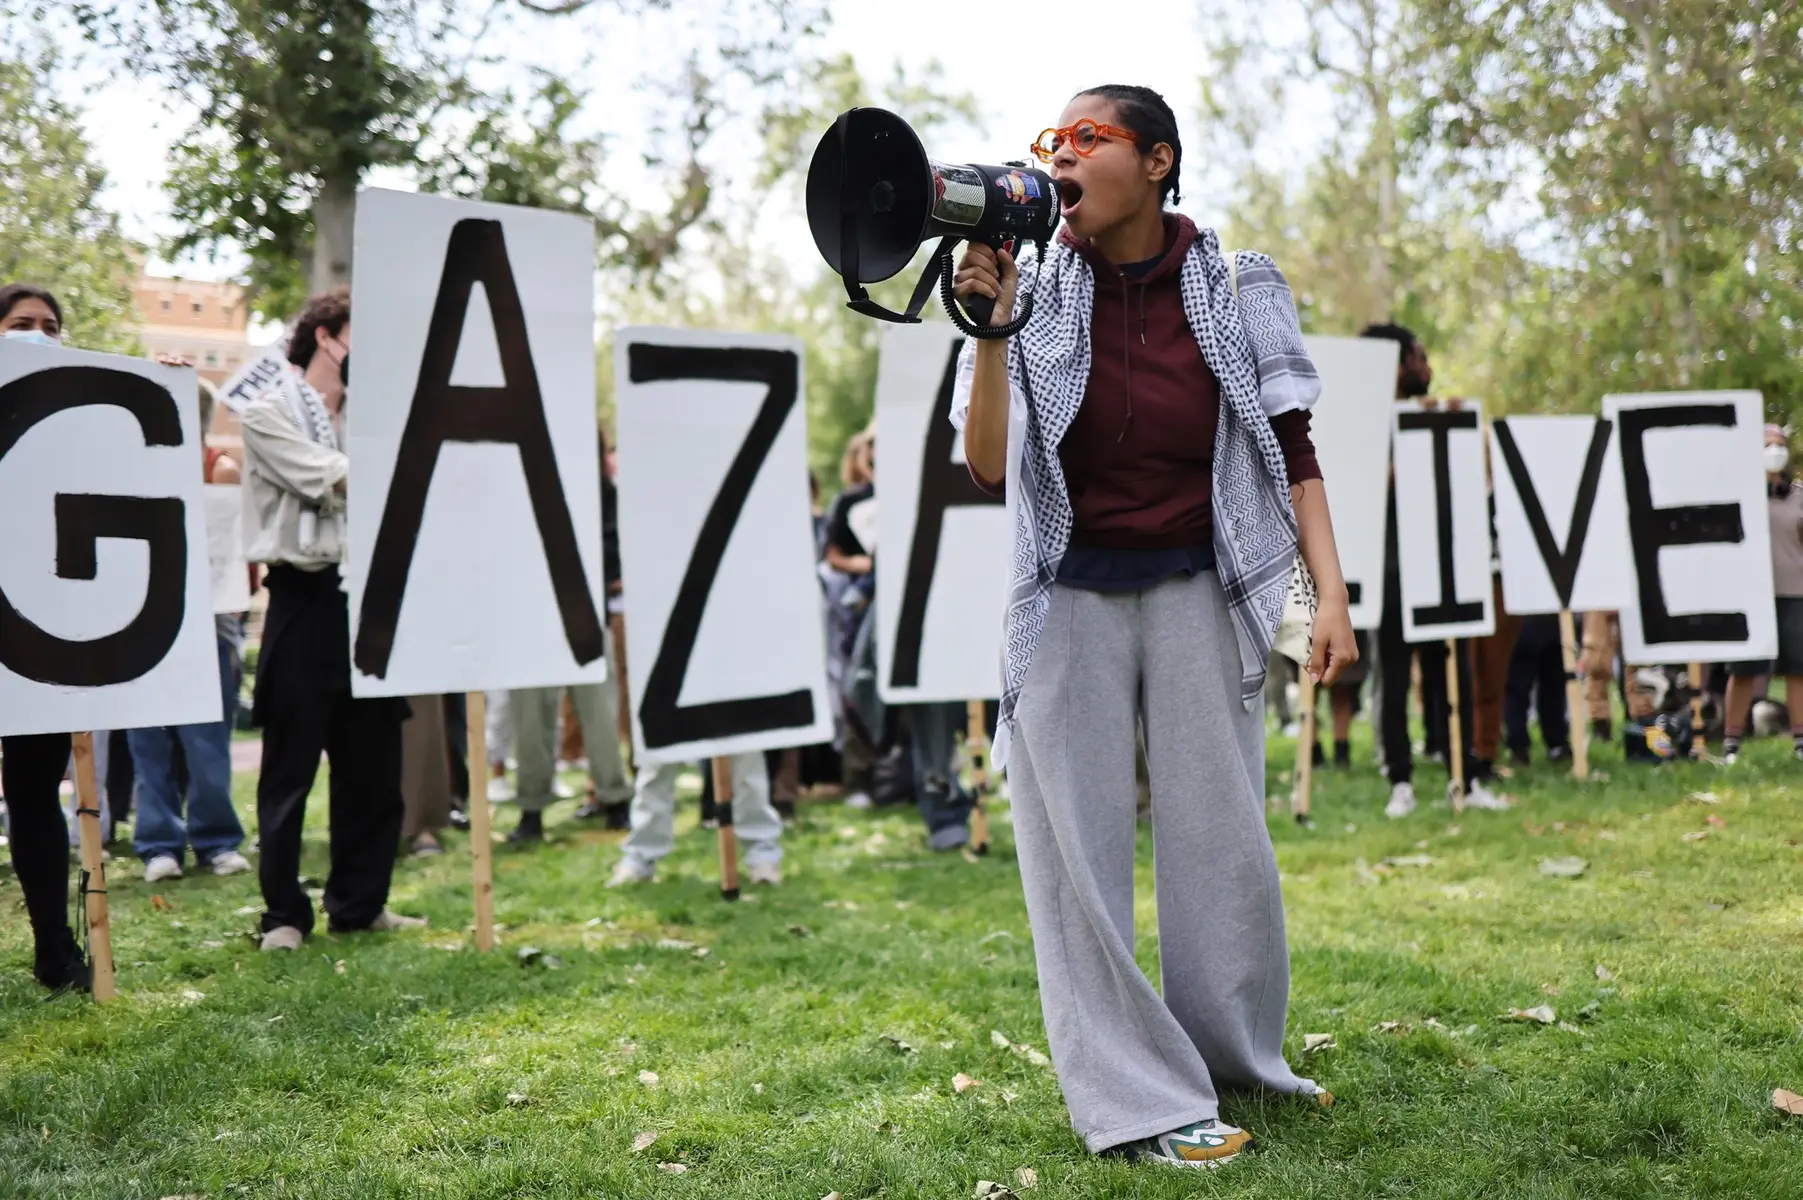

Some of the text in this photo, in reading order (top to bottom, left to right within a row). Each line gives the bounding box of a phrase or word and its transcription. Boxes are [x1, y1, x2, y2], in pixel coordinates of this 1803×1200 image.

[228, 357, 281, 400] THIS
[354, 218, 604, 679] A
[0, 365, 187, 687] G
[628, 342, 814, 749] Z
[1398, 410, 1484, 626] I
[1493, 419, 1612, 609] V
[1619, 404, 1750, 645] E
